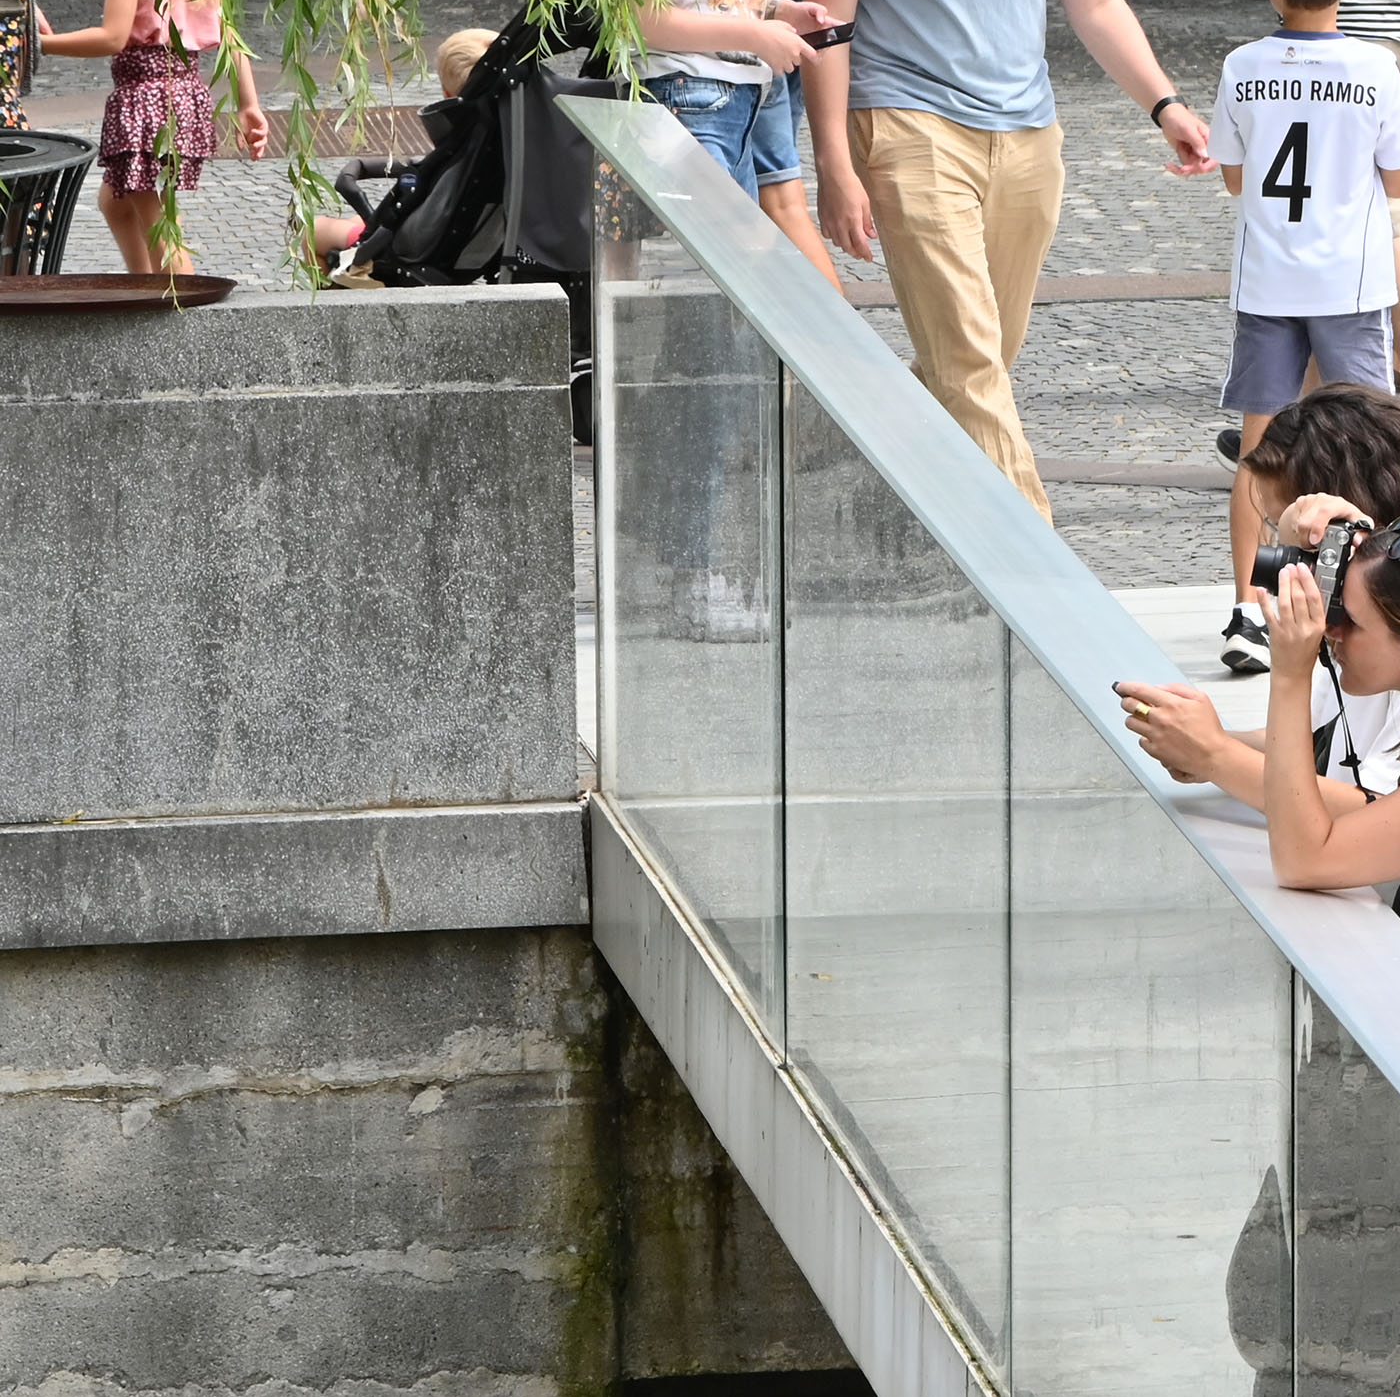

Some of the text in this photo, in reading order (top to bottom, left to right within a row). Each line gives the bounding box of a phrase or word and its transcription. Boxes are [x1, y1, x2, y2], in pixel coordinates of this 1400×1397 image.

[1235, 79, 1377, 107] SERGIO RAMOS
[1261, 121, 1312, 223] 4
